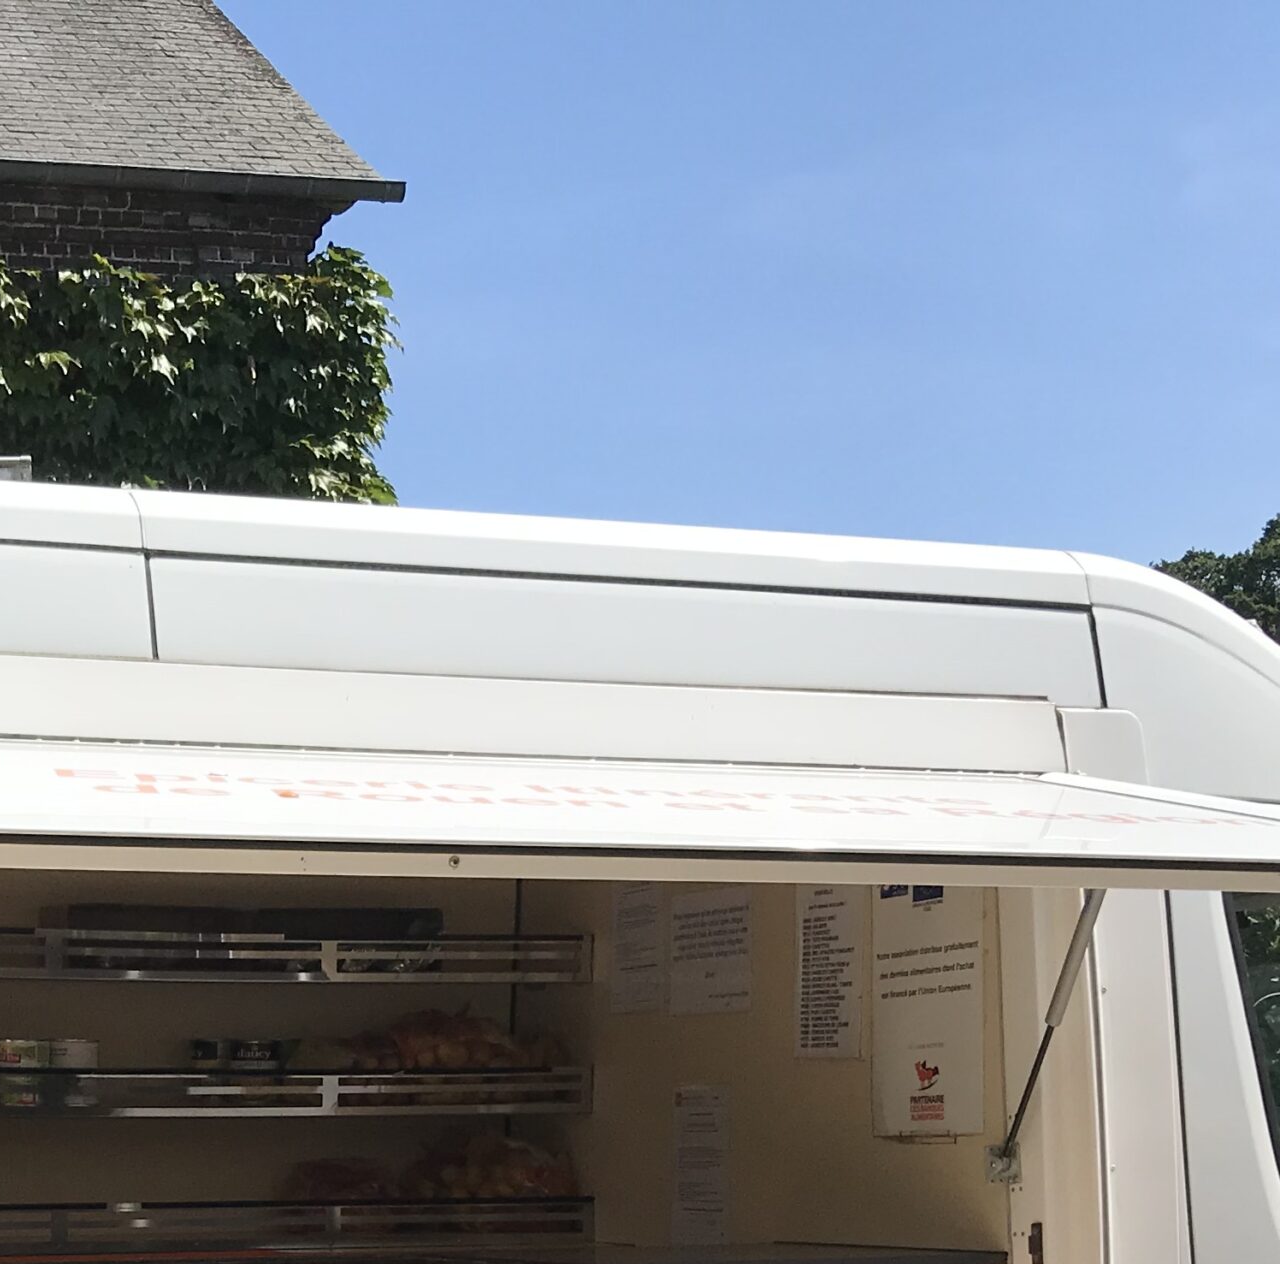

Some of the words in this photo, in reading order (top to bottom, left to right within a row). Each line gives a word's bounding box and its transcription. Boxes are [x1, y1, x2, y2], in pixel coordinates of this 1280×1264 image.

[55, 768, 495, 791] Epicerie
[94, 784, 231, 796] de
[272, 788, 628, 808] Rouen
[665, 802, 766, 812] et
[944, 940, 978, 953] gratuitement
